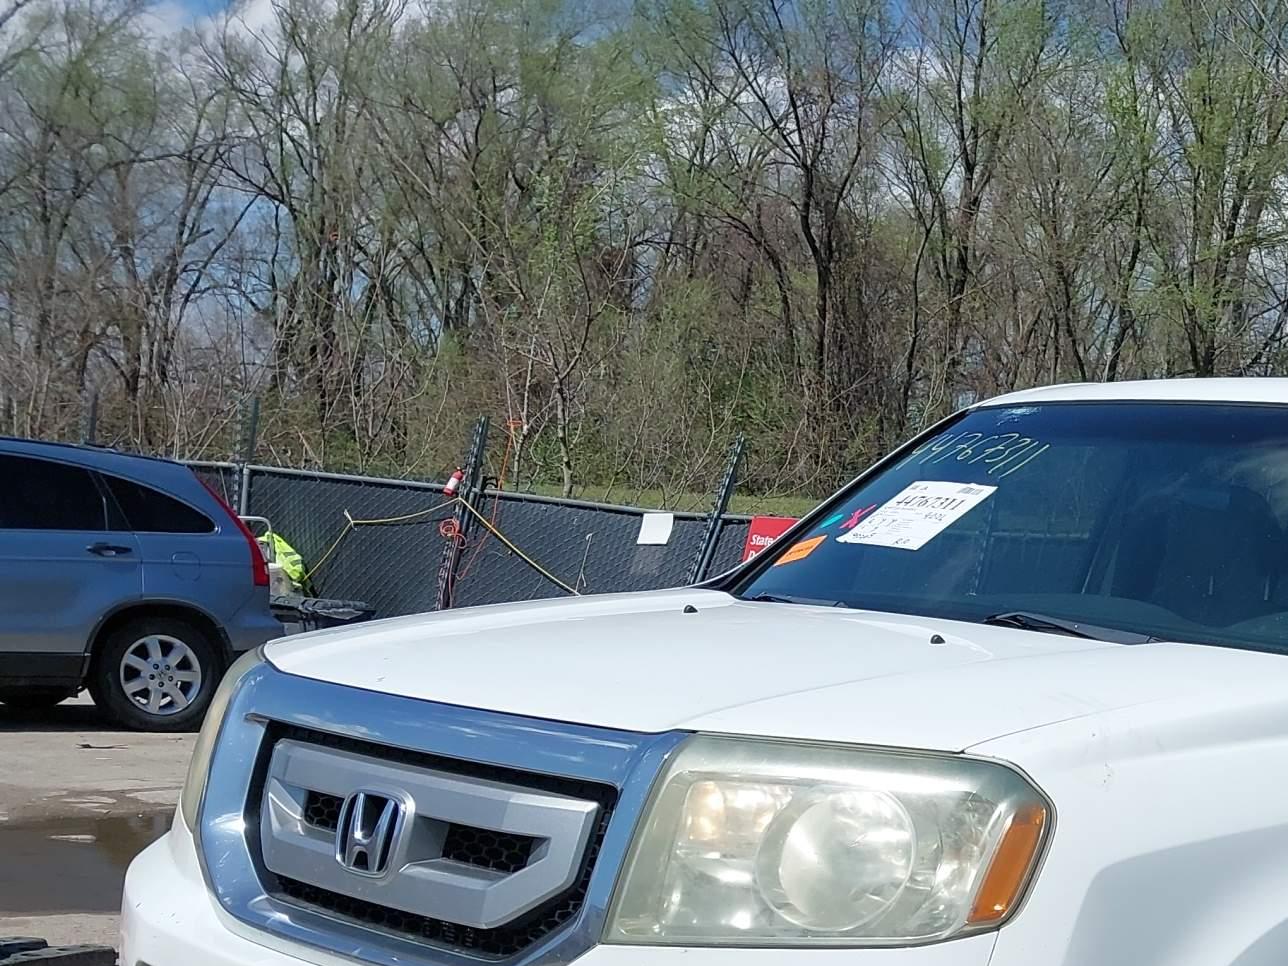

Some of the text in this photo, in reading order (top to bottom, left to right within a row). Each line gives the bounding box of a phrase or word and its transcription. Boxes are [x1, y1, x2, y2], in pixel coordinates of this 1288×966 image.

[896, 431, 1050, 479] 44767311
[896, 495, 966, 511] 44767311
[750, 534, 774, 546] State
